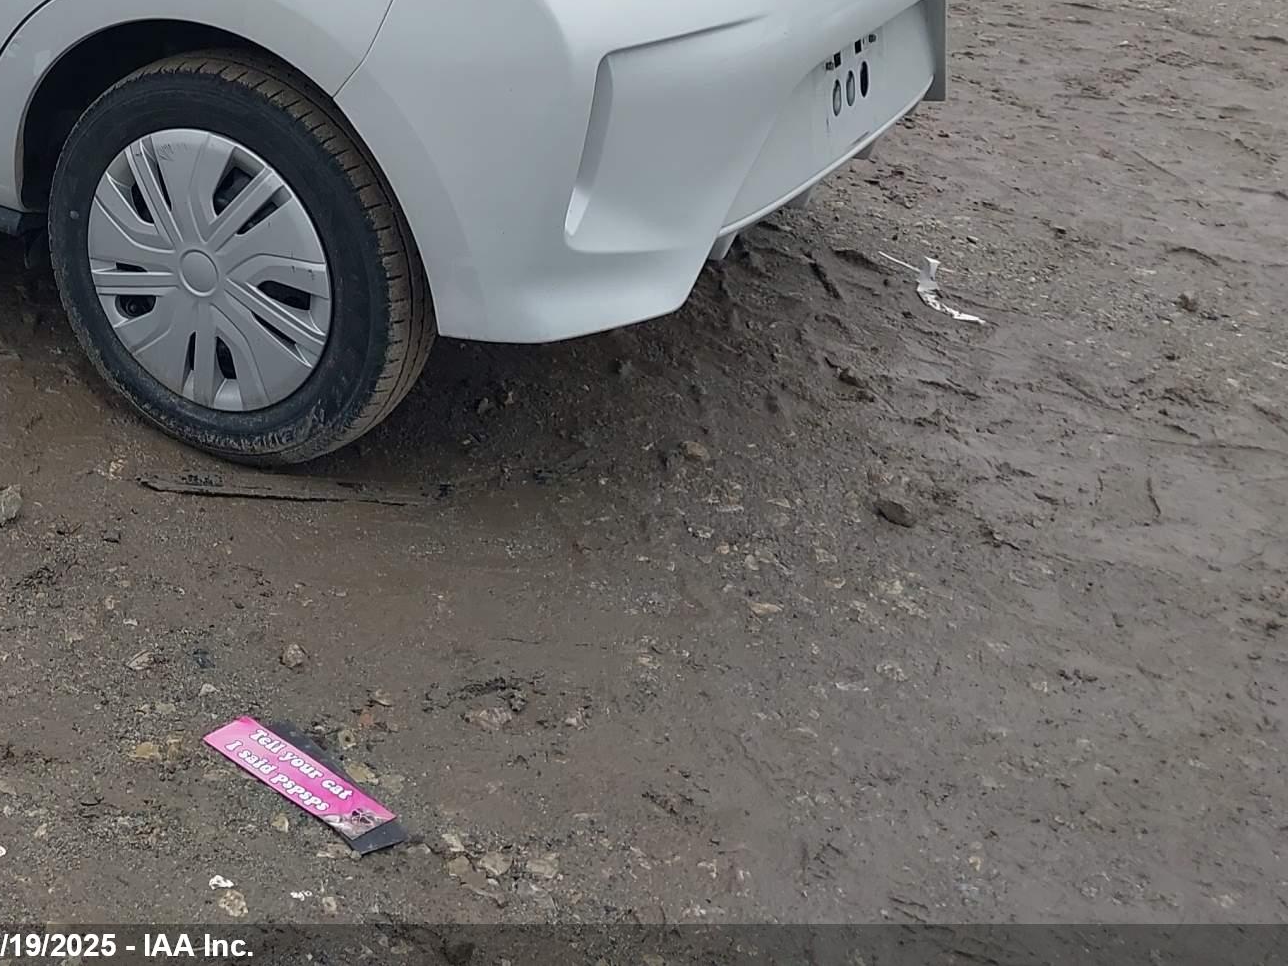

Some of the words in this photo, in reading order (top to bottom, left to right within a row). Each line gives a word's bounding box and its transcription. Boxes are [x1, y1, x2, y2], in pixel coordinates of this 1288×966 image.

[225, 740, 244, 751] I
[237, 749, 278, 775] said
[249, 729, 286, 754] Tell
[278, 750, 324, 779] your
[321, 779, 353, 800] cat
